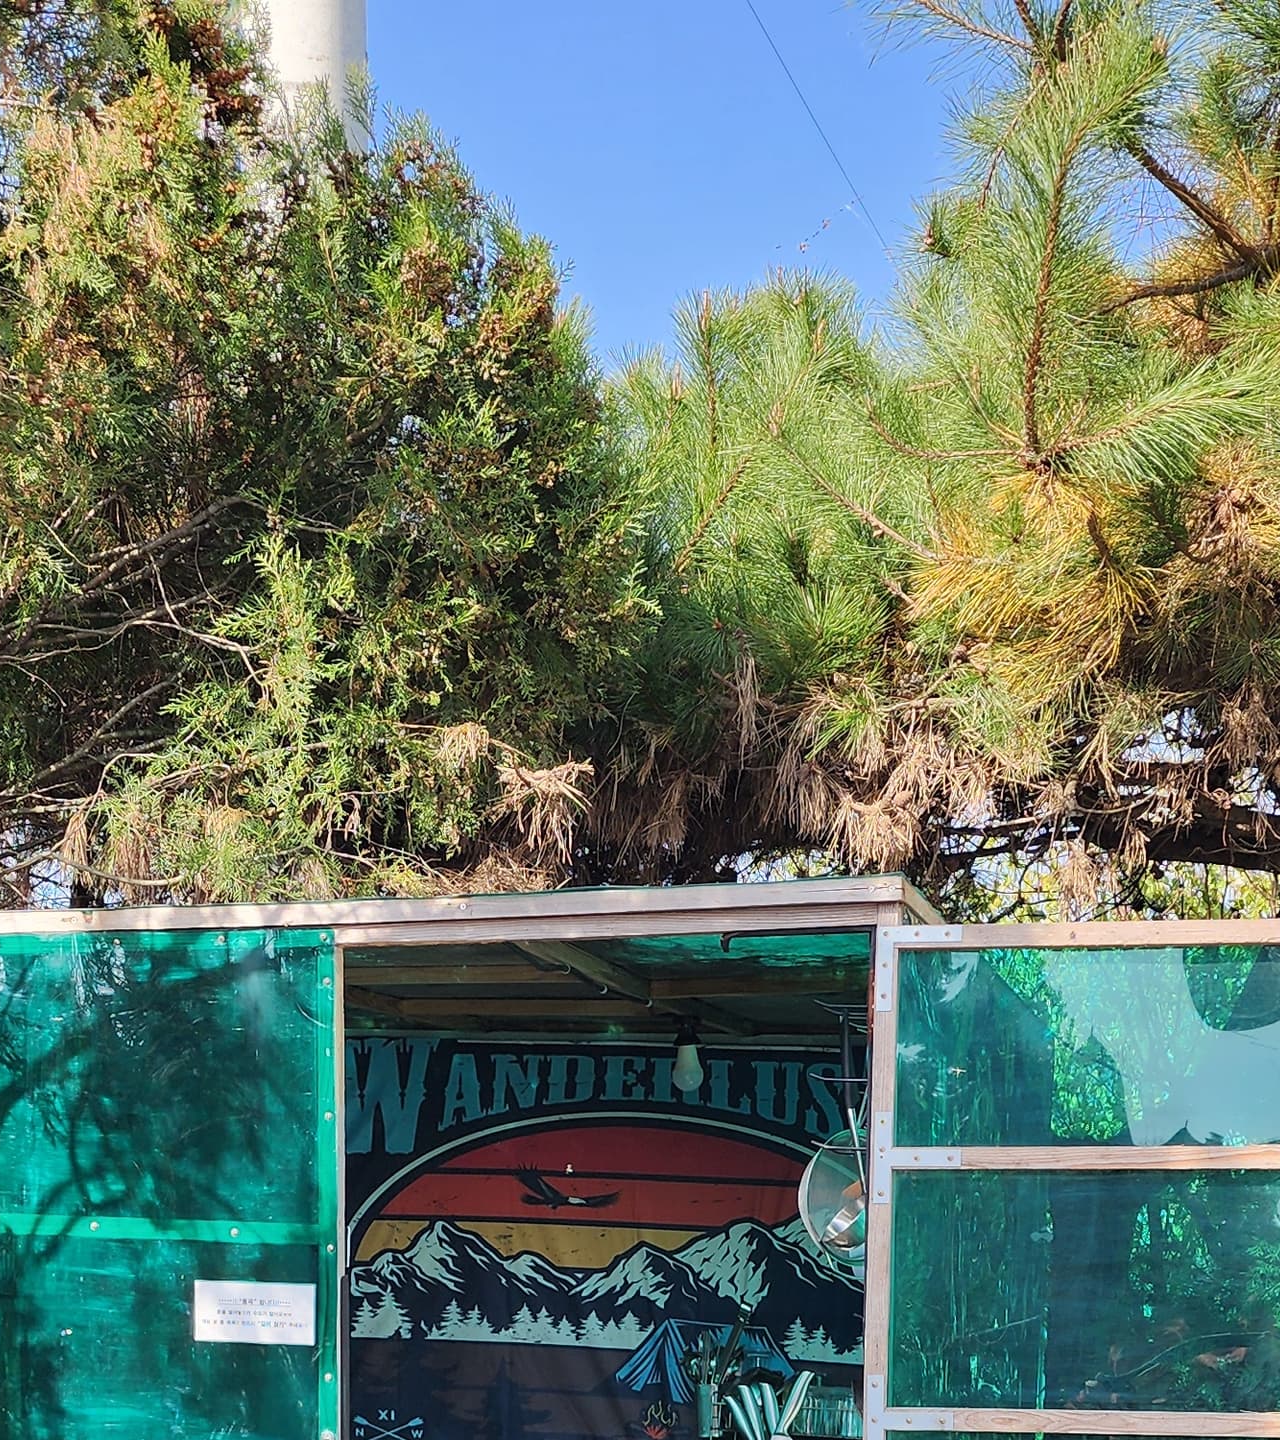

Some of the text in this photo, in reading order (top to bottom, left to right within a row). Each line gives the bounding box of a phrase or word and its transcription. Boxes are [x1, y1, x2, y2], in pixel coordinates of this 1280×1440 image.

[345, 1037, 846, 1154] WANDELUS
[378, 1409, 396, 1421] XI
[355, 1427, 424, 1439] N W
